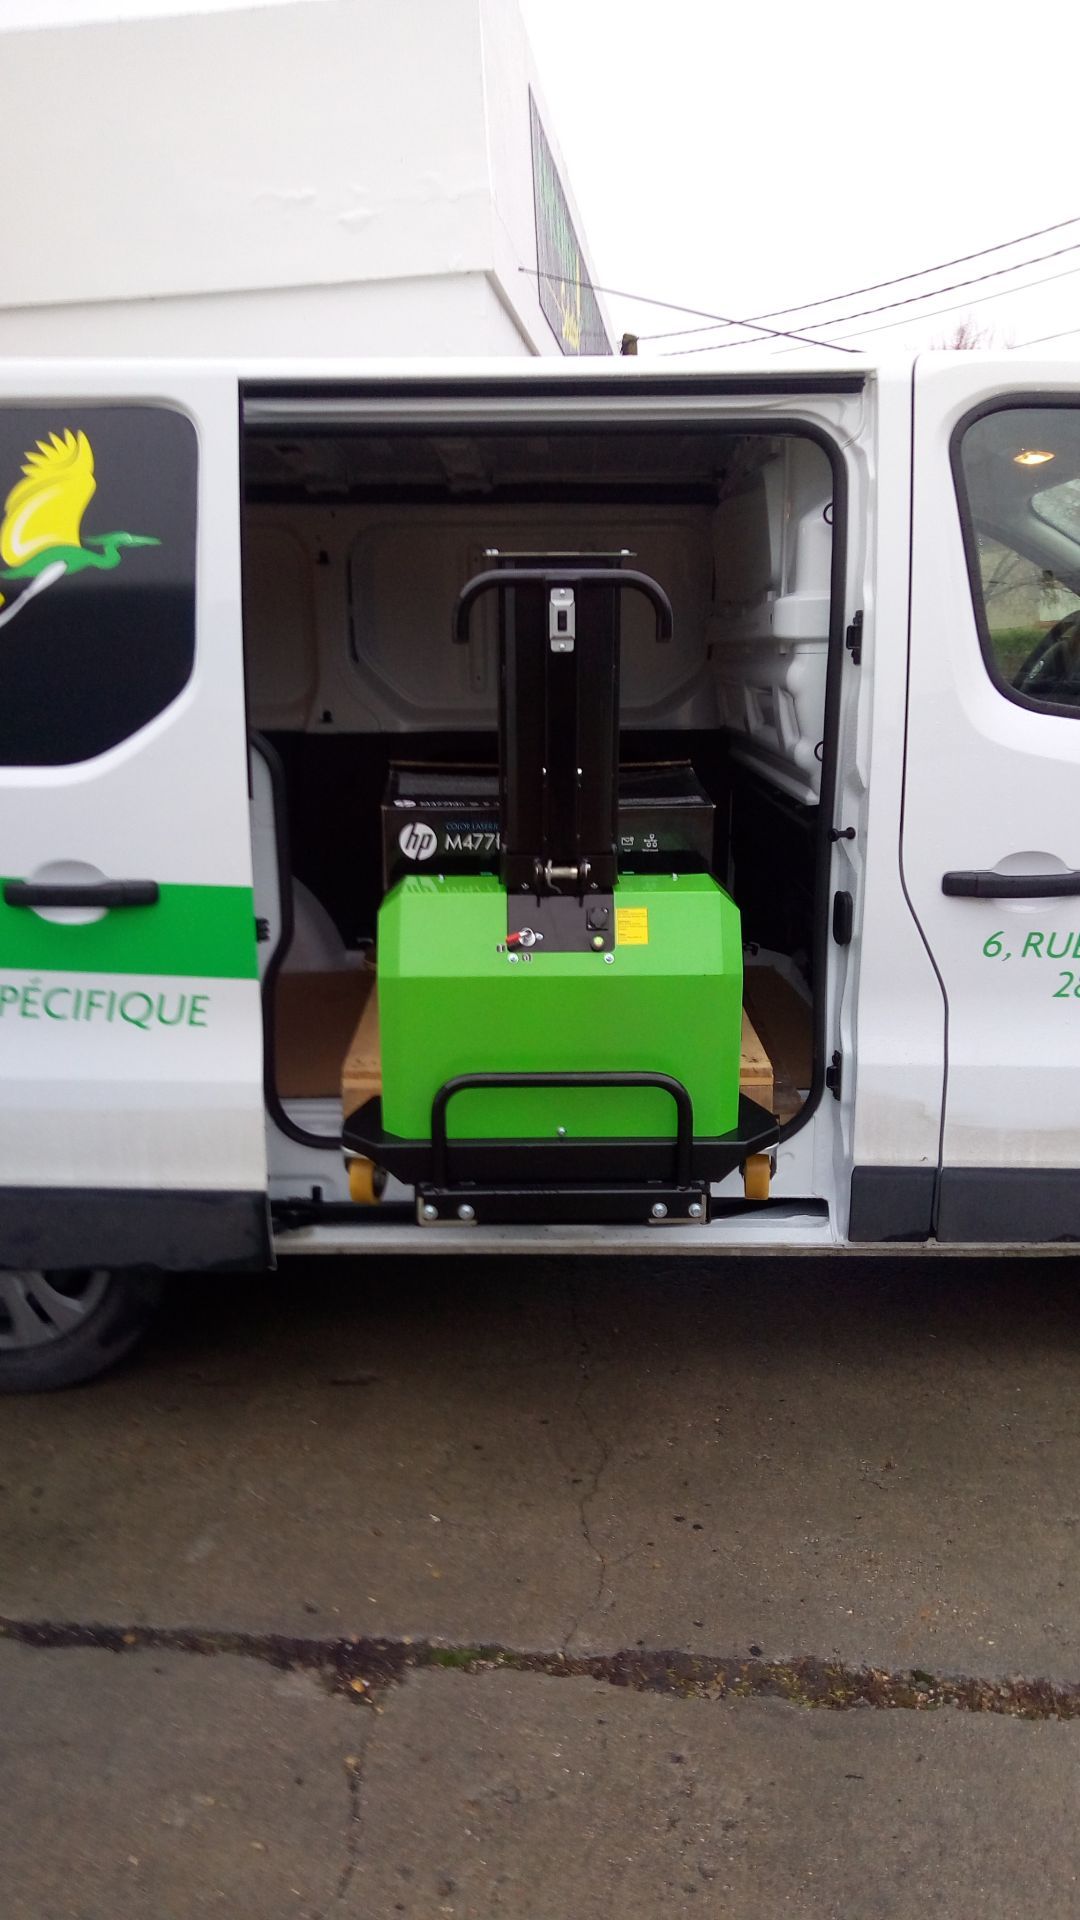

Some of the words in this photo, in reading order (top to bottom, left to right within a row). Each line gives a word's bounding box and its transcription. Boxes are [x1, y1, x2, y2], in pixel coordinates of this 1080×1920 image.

[401, 823, 436, 860] hp
[982, 930, 1012, 961] 6,
[0, 977, 210, 1030] PÉCIFIQUE
